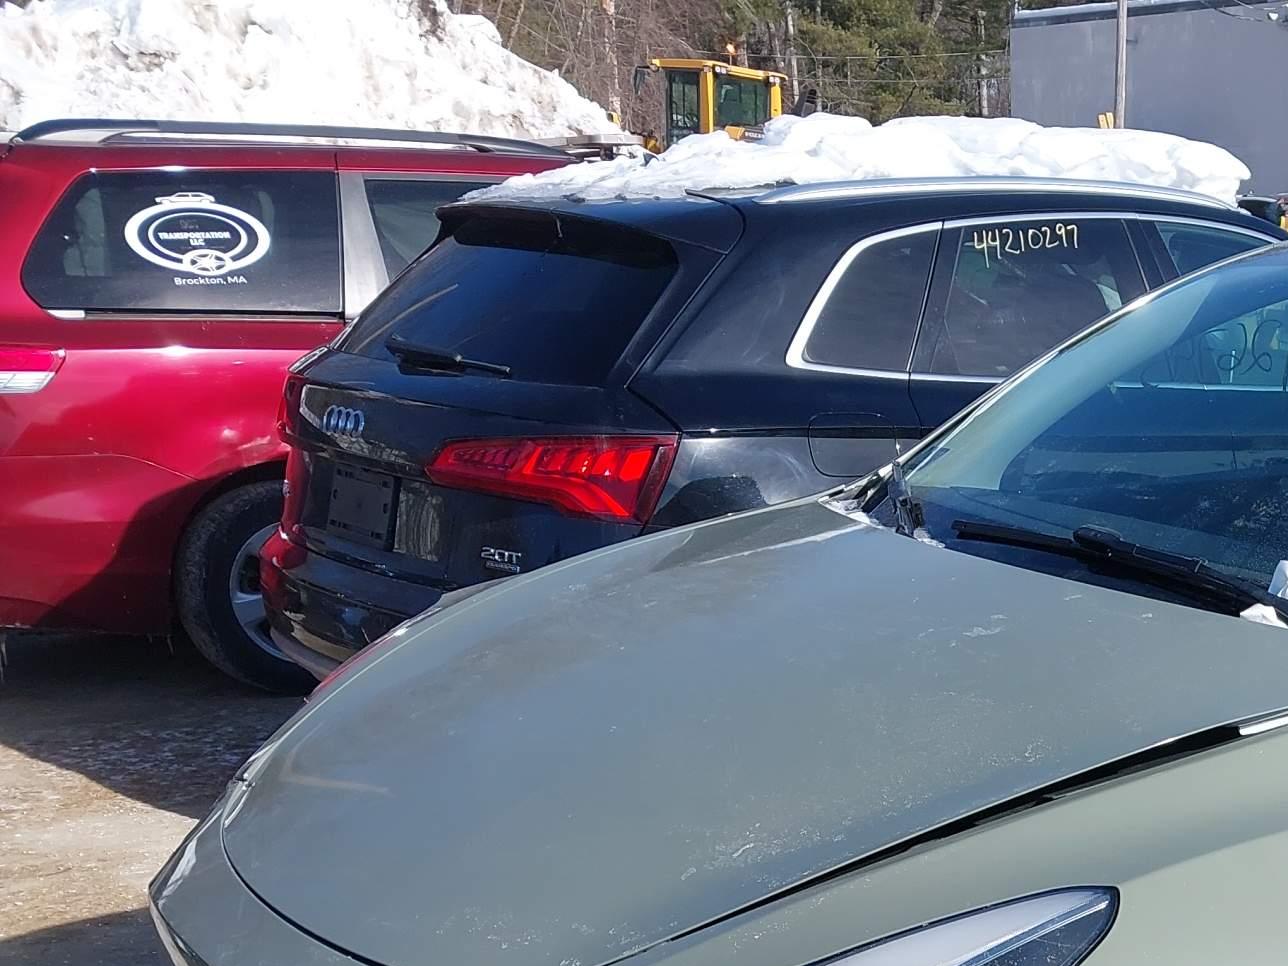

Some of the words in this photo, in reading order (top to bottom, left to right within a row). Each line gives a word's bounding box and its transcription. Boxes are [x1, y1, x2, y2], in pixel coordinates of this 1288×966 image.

[974, 223, 1078, 269] 44210297
[174, 276, 226, 286] Brockton,
[227, 275, 247, 285] MA
